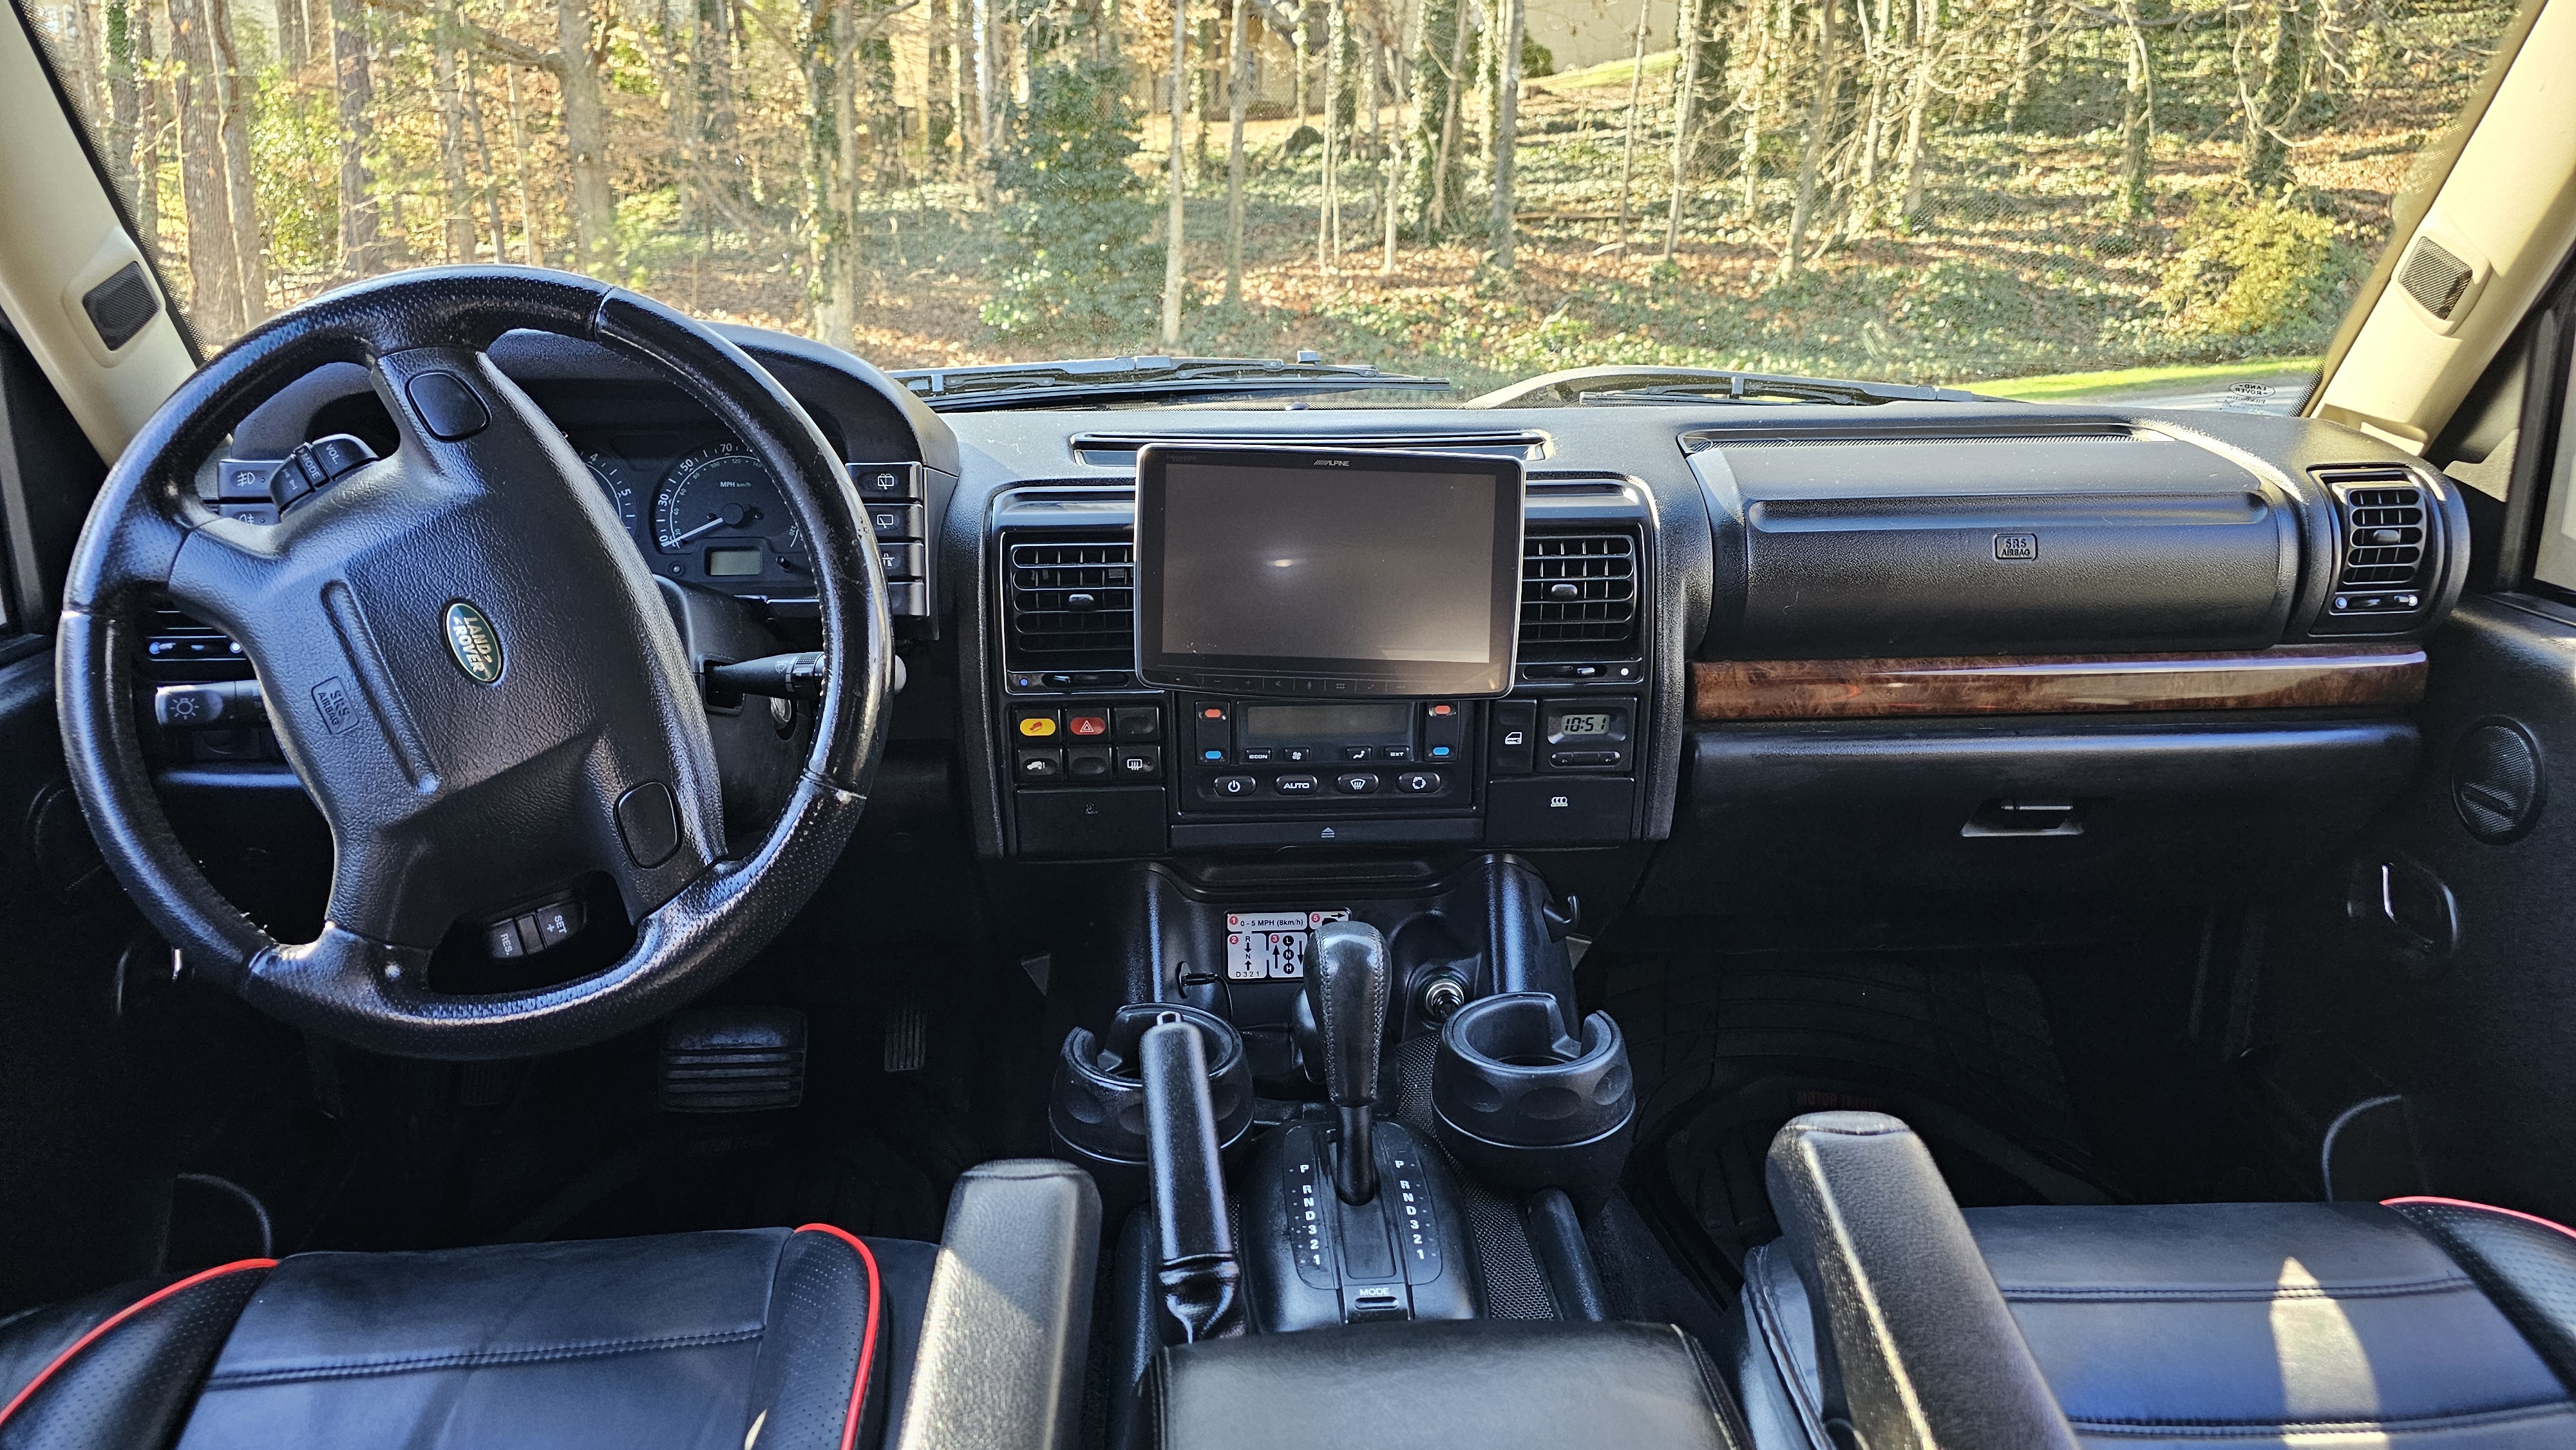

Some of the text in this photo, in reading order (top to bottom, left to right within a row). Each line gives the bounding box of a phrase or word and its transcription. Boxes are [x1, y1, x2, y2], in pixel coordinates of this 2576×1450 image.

[720, 443, 732, 453] 70
[590, 453, 598, 462] 4
[300, 453, 321, 480] MODE
[679, 458, 694, 472] 50
[658, 494, 669, 507] 30
[2005, 538, 2027, 549] SRS
[2001, 549, 2031, 557] AIRBAG
[464, 617, 492, 654] LAND
[453, 625, 486, 673] ROVER
[317, 692, 339, 726] AIRBAG
[330, 690, 350, 717] SRS
[1564, 717, 1606, 732] 10:51
[554, 915, 567, 933] SET
[500, 933, 513, 955] RES.
[1300, 1164, 1309, 1173] P
[1395, 1160, 1405, 1169] P
[1302, 1185, 1312, 1194] R
[1399, 1180, 1410, 1189] R
[1303, 1198, 1314, 1207] N
[1403, 1192, 1414, 1202] N
[1305, 1210, 1316, 1221] D
[1406, 1205, 1417, 1216] D
[1308, 1224, 1317, 1235] 3
[1410, 1219, 1419, 1229] 3
[1310, 1239, 1319, 1250] 2
[1413, 1234, 1423, 1244] 2
[1313, 1254, 1320, 1265] 1
[1417, 1248, 1425, 1260] 1
[1359, 1288, 1390, 1296] MODE
